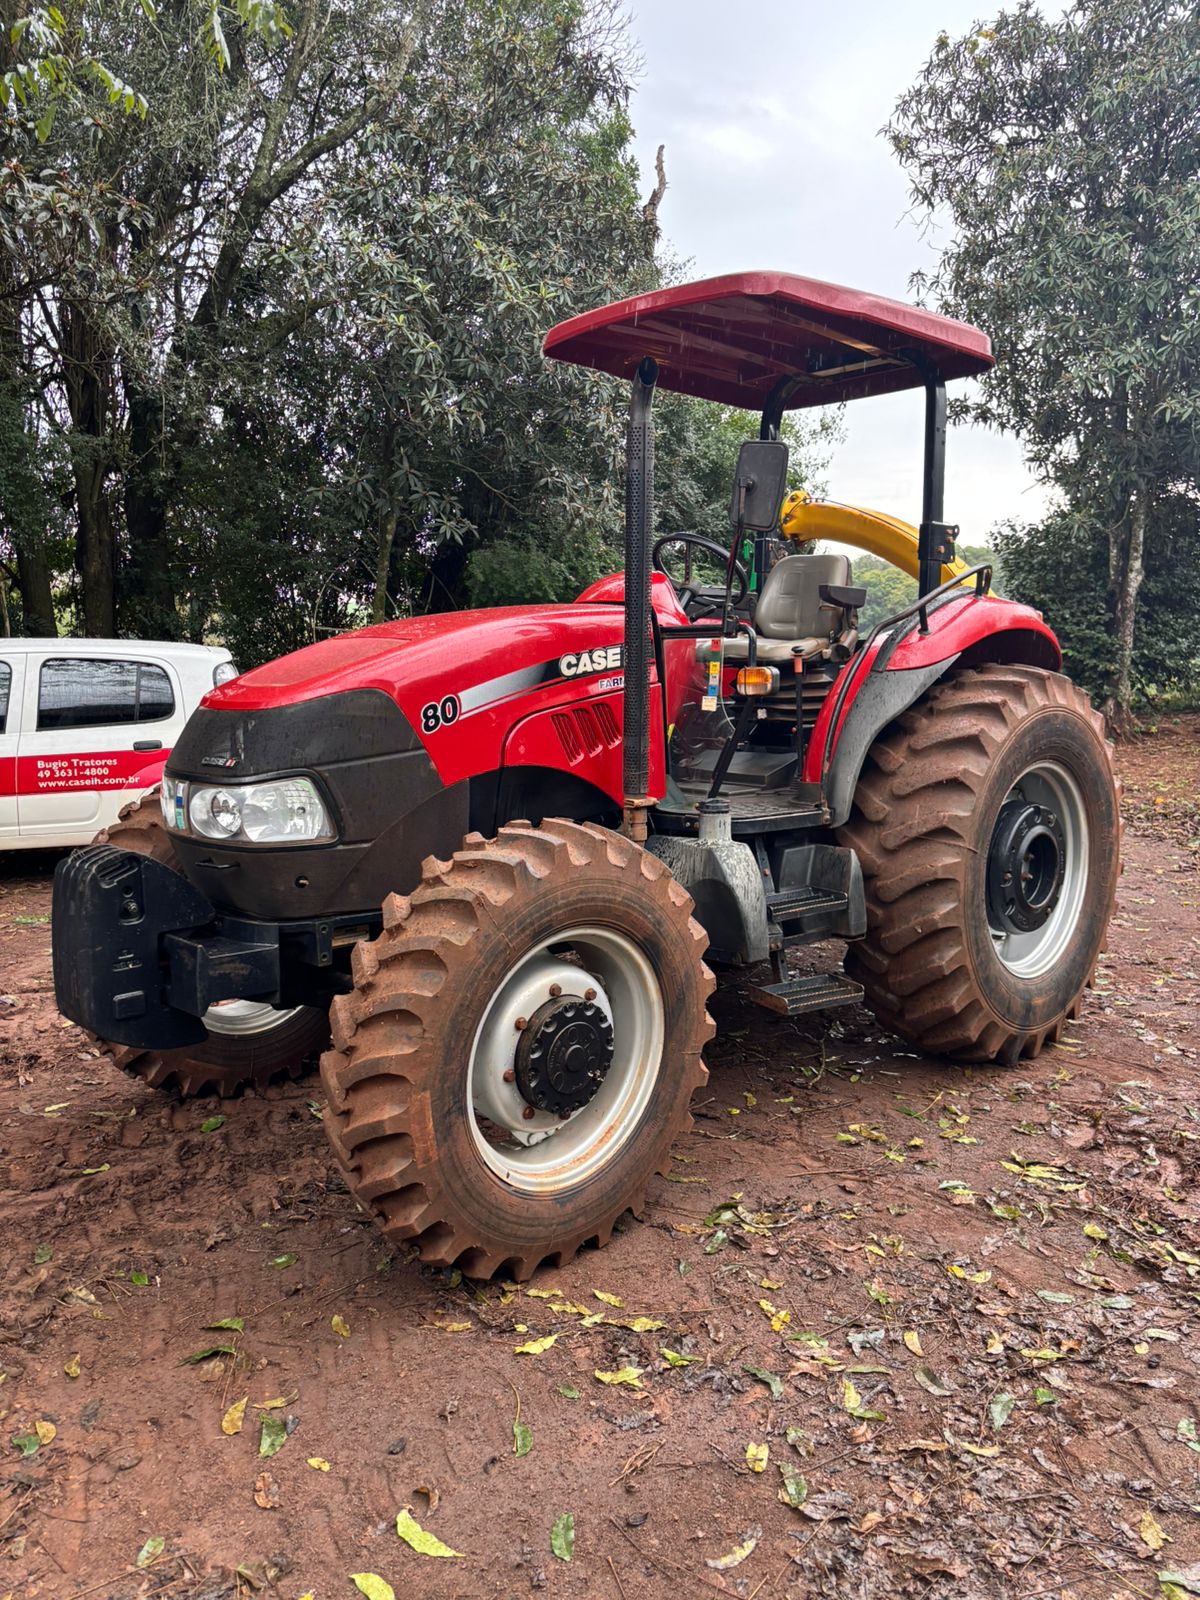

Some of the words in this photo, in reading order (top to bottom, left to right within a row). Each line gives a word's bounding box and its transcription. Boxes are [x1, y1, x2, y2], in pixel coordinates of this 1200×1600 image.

[560, 648, 621, 677] CASE
[421, 694, 460, 734] 80
[37, 760, 68, 771] Bugio
[71, 758, 118, 768] Tratores
[37, 770, 51, 779] 49
[53, 767, 109, 778] 3631-4800
[38, 775, 140, 788] www.caseih.com.br
